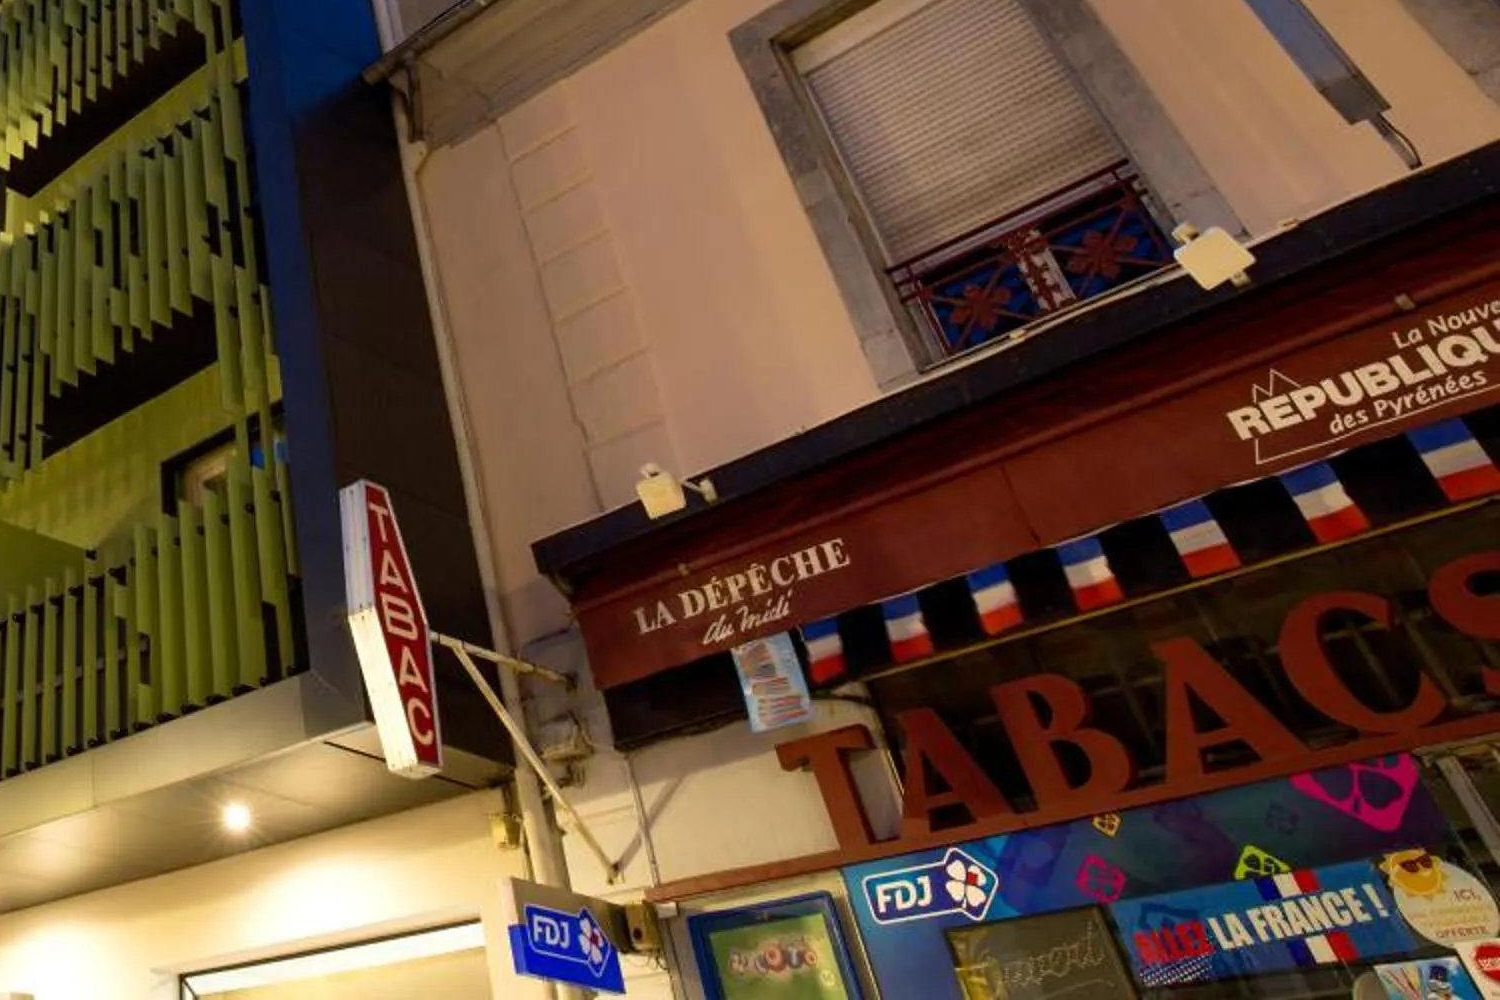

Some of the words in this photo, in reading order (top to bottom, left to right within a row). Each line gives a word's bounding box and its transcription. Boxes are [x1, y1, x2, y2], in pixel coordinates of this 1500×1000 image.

[1391, 327, 1424, 349] La
[1328, 407, 1369, 435] des
[1373, 370, 1488, 418] Pyrénées
[632, 600, 677, 635] LA
[677, 537, 851, 619] DÉPÊCHE
[367, 502, 434, 746] TABAC
[702, 613, 735, 645] du
[875, 875, 933, 913] FDJ
[1206, 913, 1255, 951] LA
[1246, 887, 1373, 943] FRANCE
[1361, 882, 1389, 918] !
[532, 914, 570, 949] FDJ
